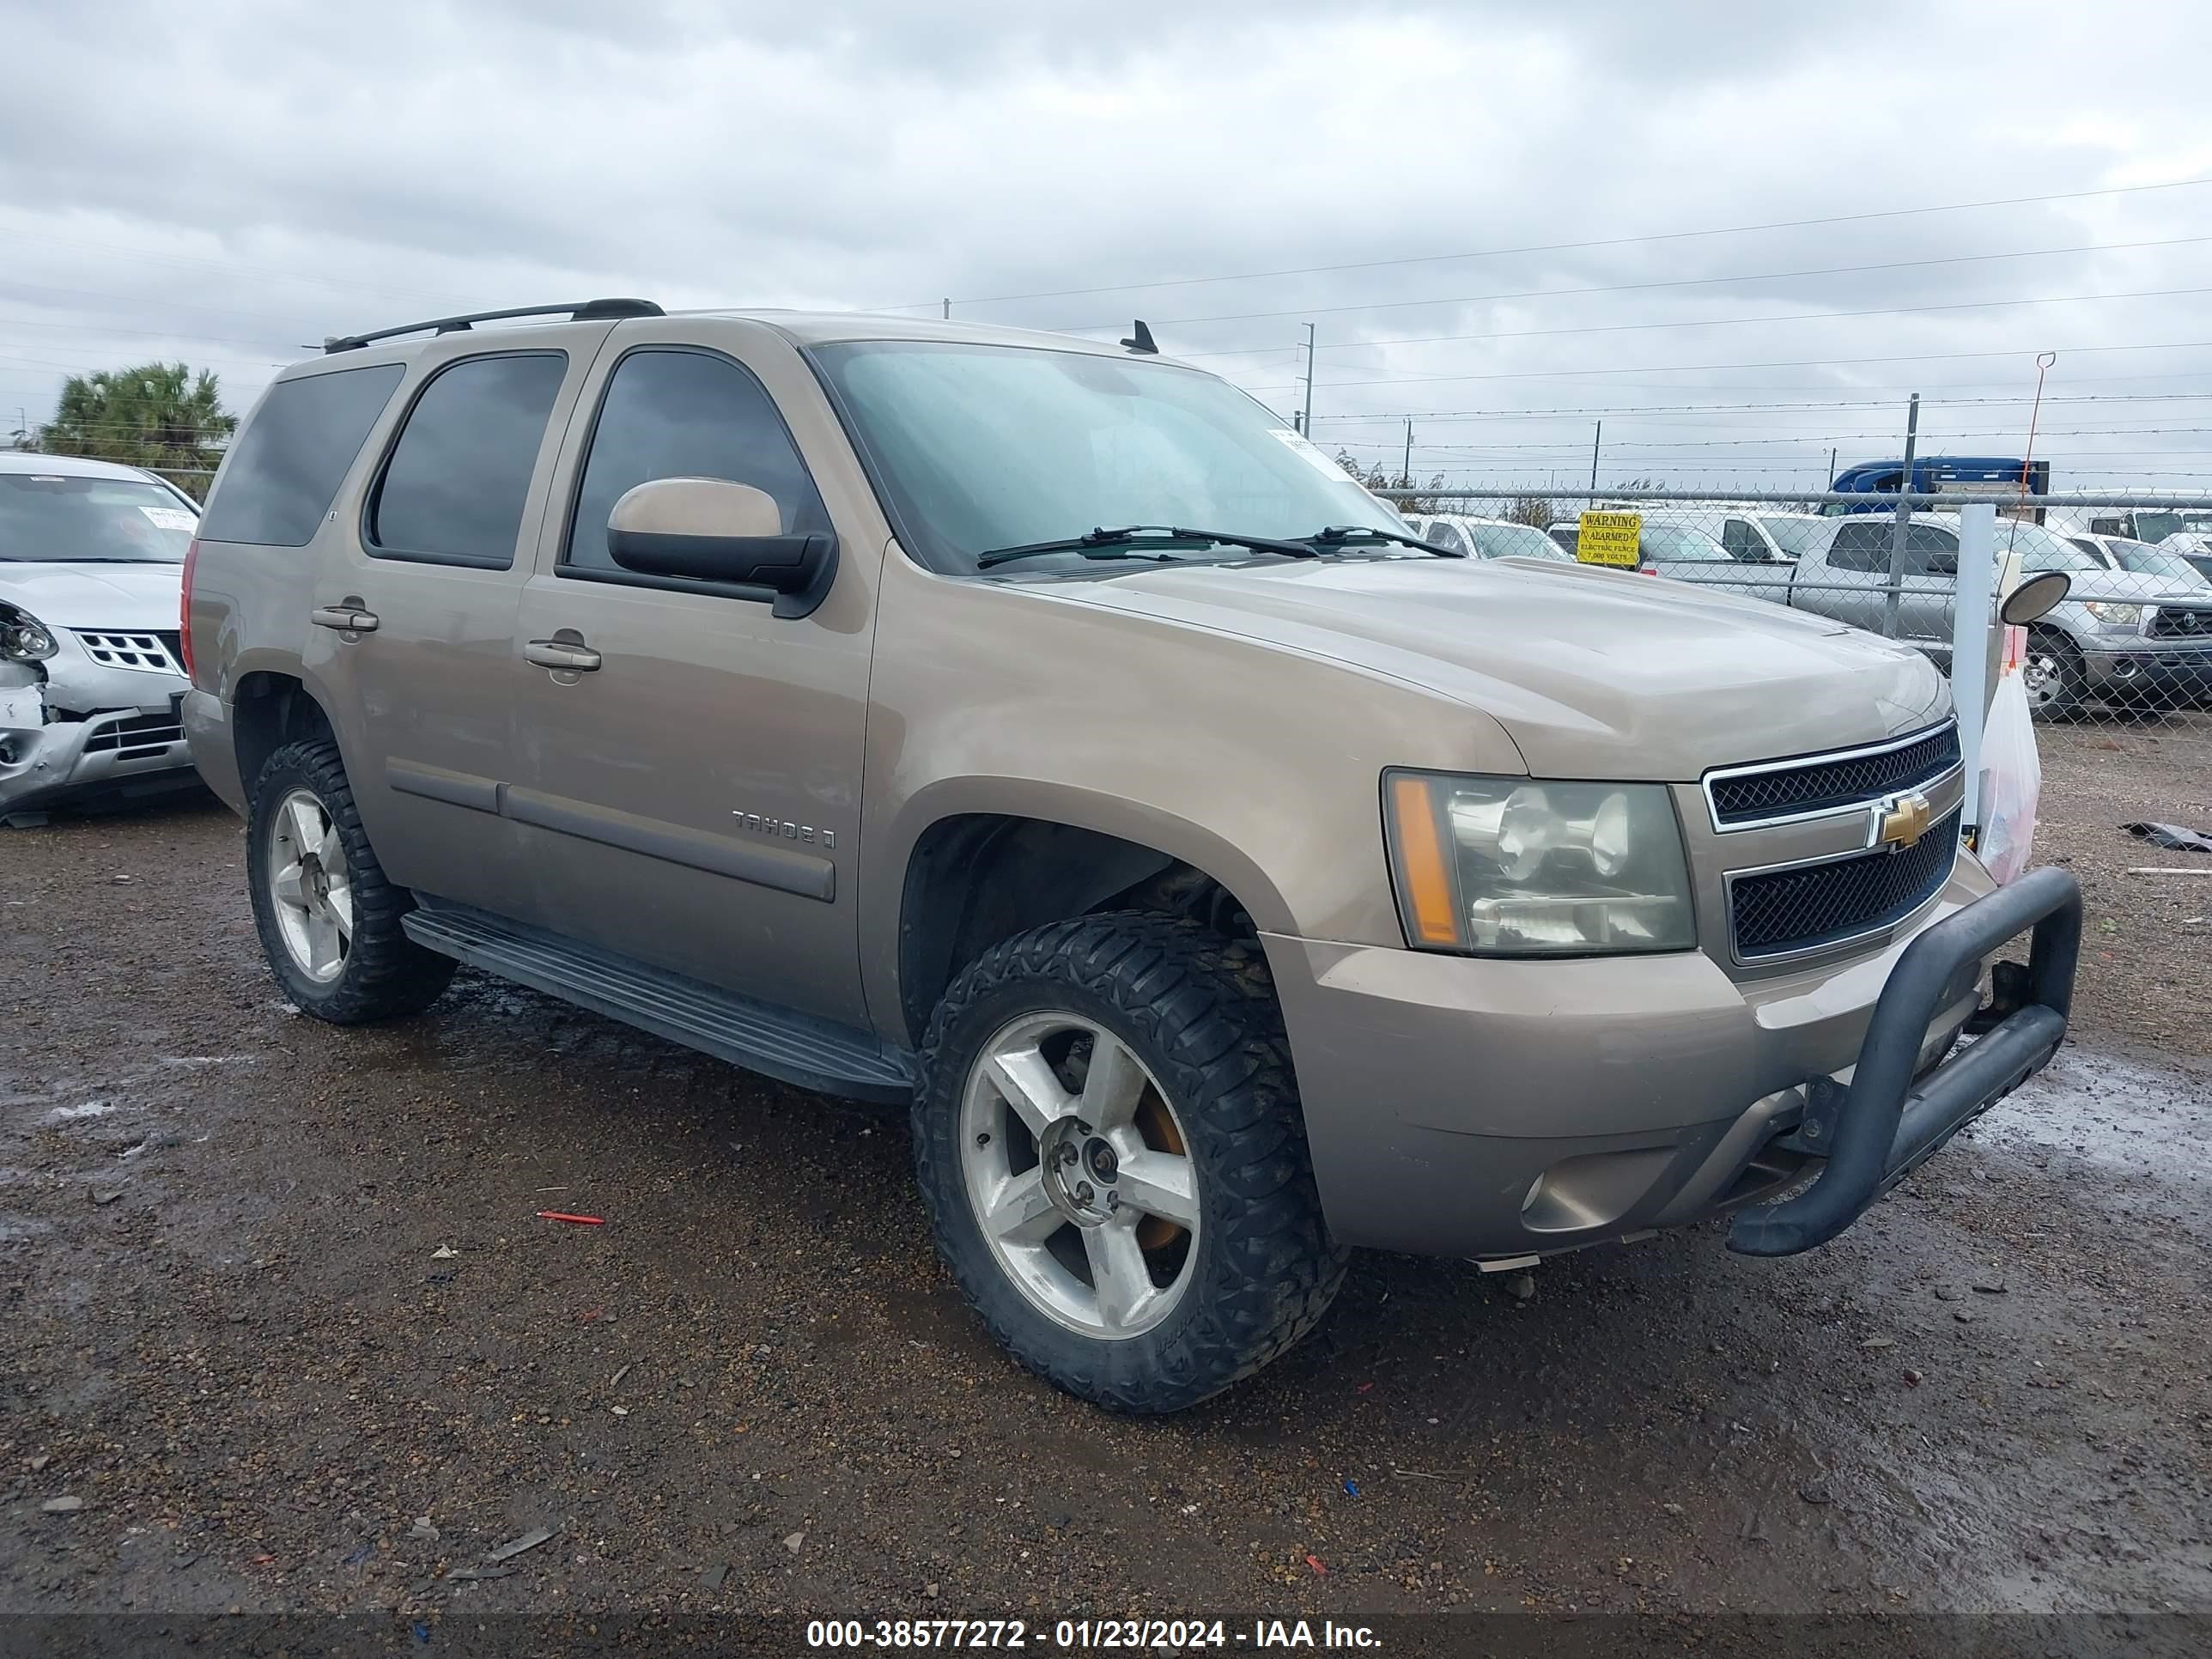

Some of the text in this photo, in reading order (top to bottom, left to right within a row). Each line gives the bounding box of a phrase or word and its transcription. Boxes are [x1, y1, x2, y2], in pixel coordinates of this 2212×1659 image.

[1585, 514, 1637, 527] WARNING
[1589, 531, 1629, 542] ALARMED
[732, 810, 815, 843] TAHOE
